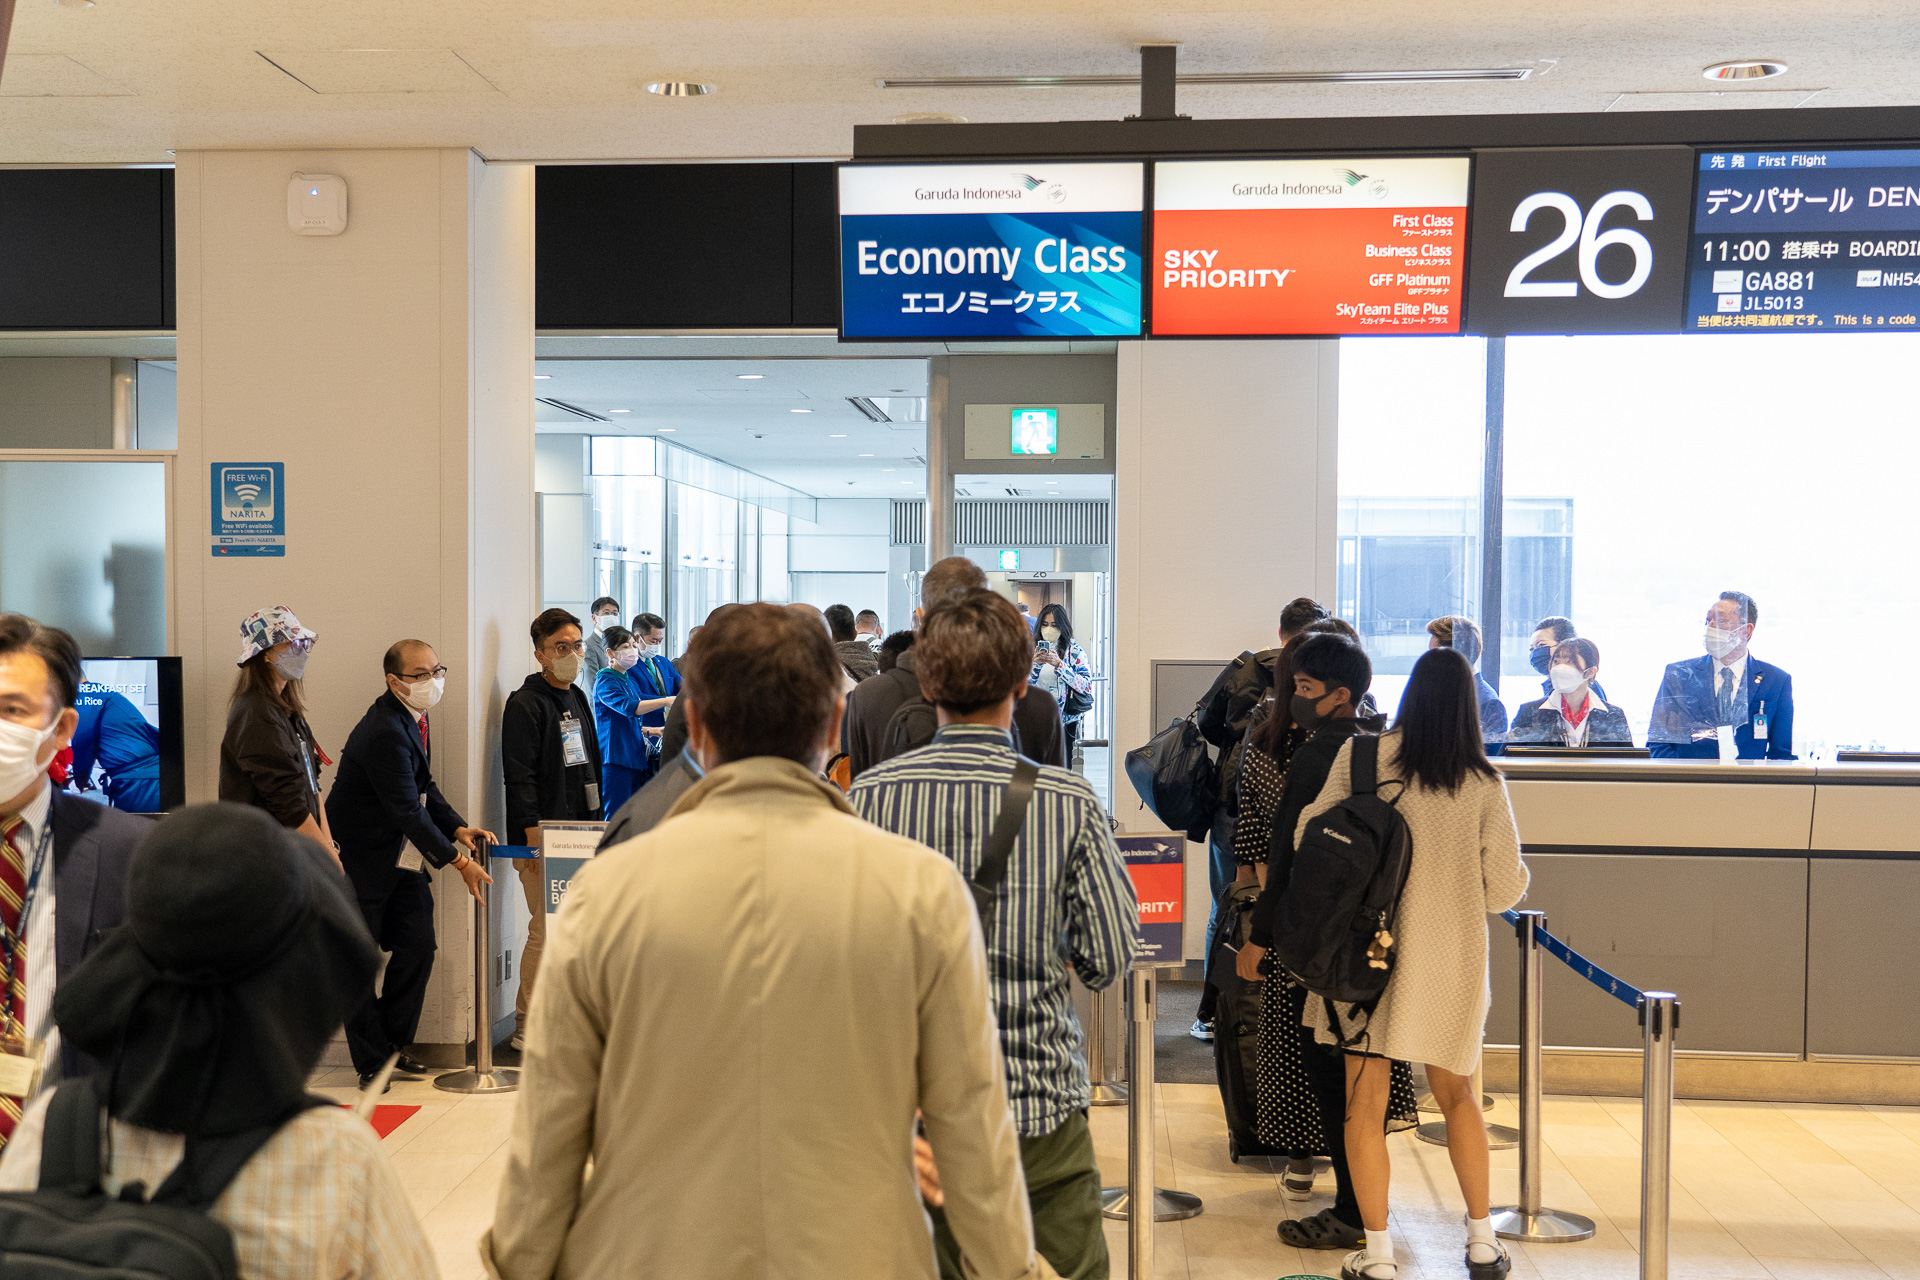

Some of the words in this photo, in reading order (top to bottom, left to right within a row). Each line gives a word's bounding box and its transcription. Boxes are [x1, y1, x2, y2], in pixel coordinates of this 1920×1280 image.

[1757, 155, 1786, 167] First
[1790, 154, 1827, 168] Flight
[914, 187, 960, 201] Garuda
[962, 186, 1022, 200] Indonesia
[1232, 183, 1278, 196] Garuda
[1282, 182, 1342, 195] Indonesia
[1706, 187, 1854, 215] デンパサール
[1868, 186, 1920, 208] DEN
[1392, 214, 1420, 228] First
[1422, 213, 1454, 227] Class
[1402, 228, 1453, 237] ファーストクラス
[1365, 243, 1418, 257] Business
[1421, 243, 1453, 257] Class
[1502, 189, 1655, 299] 26
[1703, 240, 1771, 262] 11:00
[1782, 240, 1839, 260] 搭乗中
[1849, 240, 1920, 257] BOARDI
[858, 240, 1022, 281] Economy
[1034, 238, 1127, 274] Class
[1163, 249, 1219, 269] SKY
[1404, 258, 1451, 267] ビジネスクラス
[1369, 273, 1394, 287] GFF
[1396, 273, 1451, 286] Platinum
[1745, 271, 1815, 291] GA881
[901, 290, 1082, 315] エコノミークラス
[1335, 303, 1391, 318] SkyTeam
[1393, 303, 1420, 316] Elite
[1422, 302, 1449, 315] Plus
[1744, 296, 1804, 311] JL5013
[1697, 313, 1824, 328] 当便は共同運航便です。
[1834, 314, 1858, 325] This
[1862, 314, 1872, 325] is
[1876, 316, 1885, 325] a
[1888, 314, 1917, 325] code
[227, 474, 246, 482] FREE
[247, 474, 268, 482] Wi-Fi
[230, 510, 266, 518] NARITA
[79, 683, 127, 693] REAKFAST
[129, 683, 147, 693] SET
[84, 696, 103, 706] Rice
[1131, 849, 1158, 857] Indonesia
